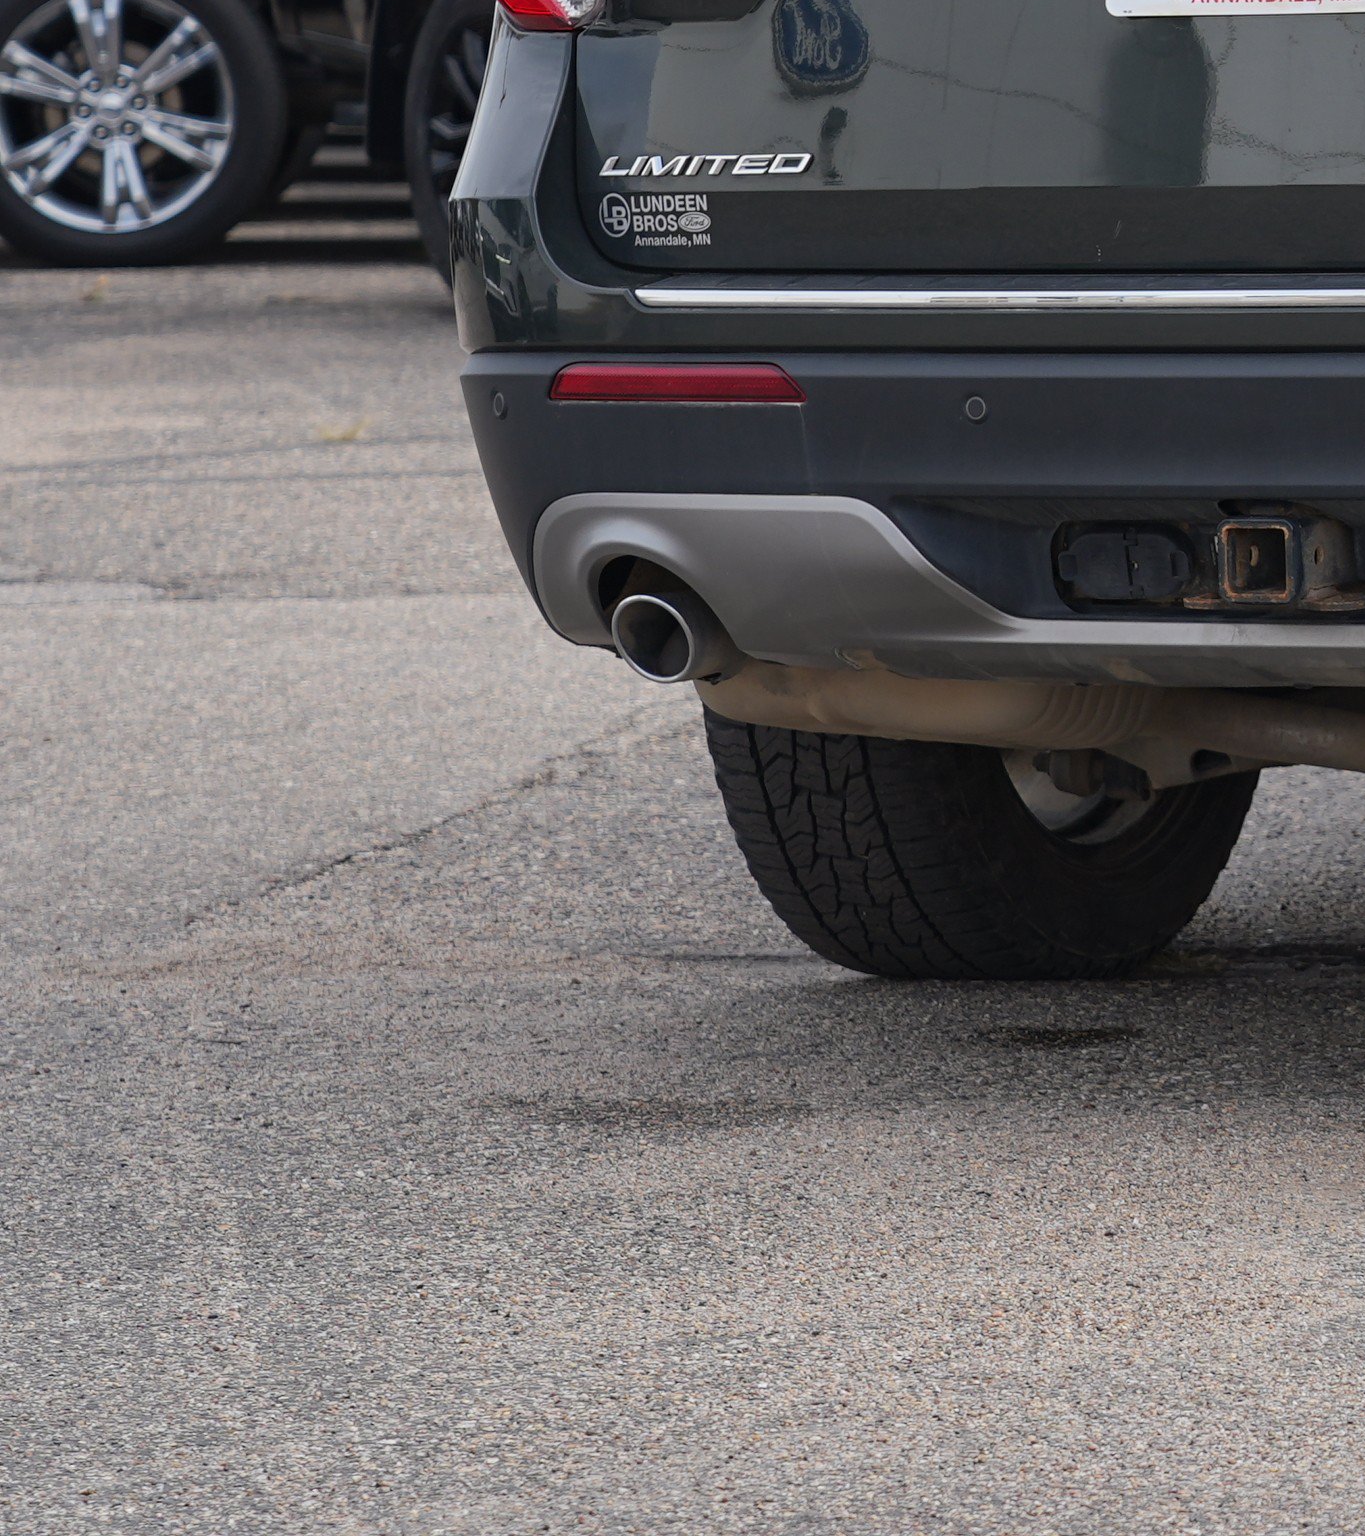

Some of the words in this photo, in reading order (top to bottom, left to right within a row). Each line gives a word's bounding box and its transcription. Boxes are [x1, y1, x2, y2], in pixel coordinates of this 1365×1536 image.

[598, 152, 814, 178] LIMITED
[630, 194, 708, 214] LUNDEEN
[632, 214, 678, 233] BROS
[682, 215, 706, 228] Ford
[634, 234, 692, 248] Annandale,
[693, 233, 711, 246] MN
